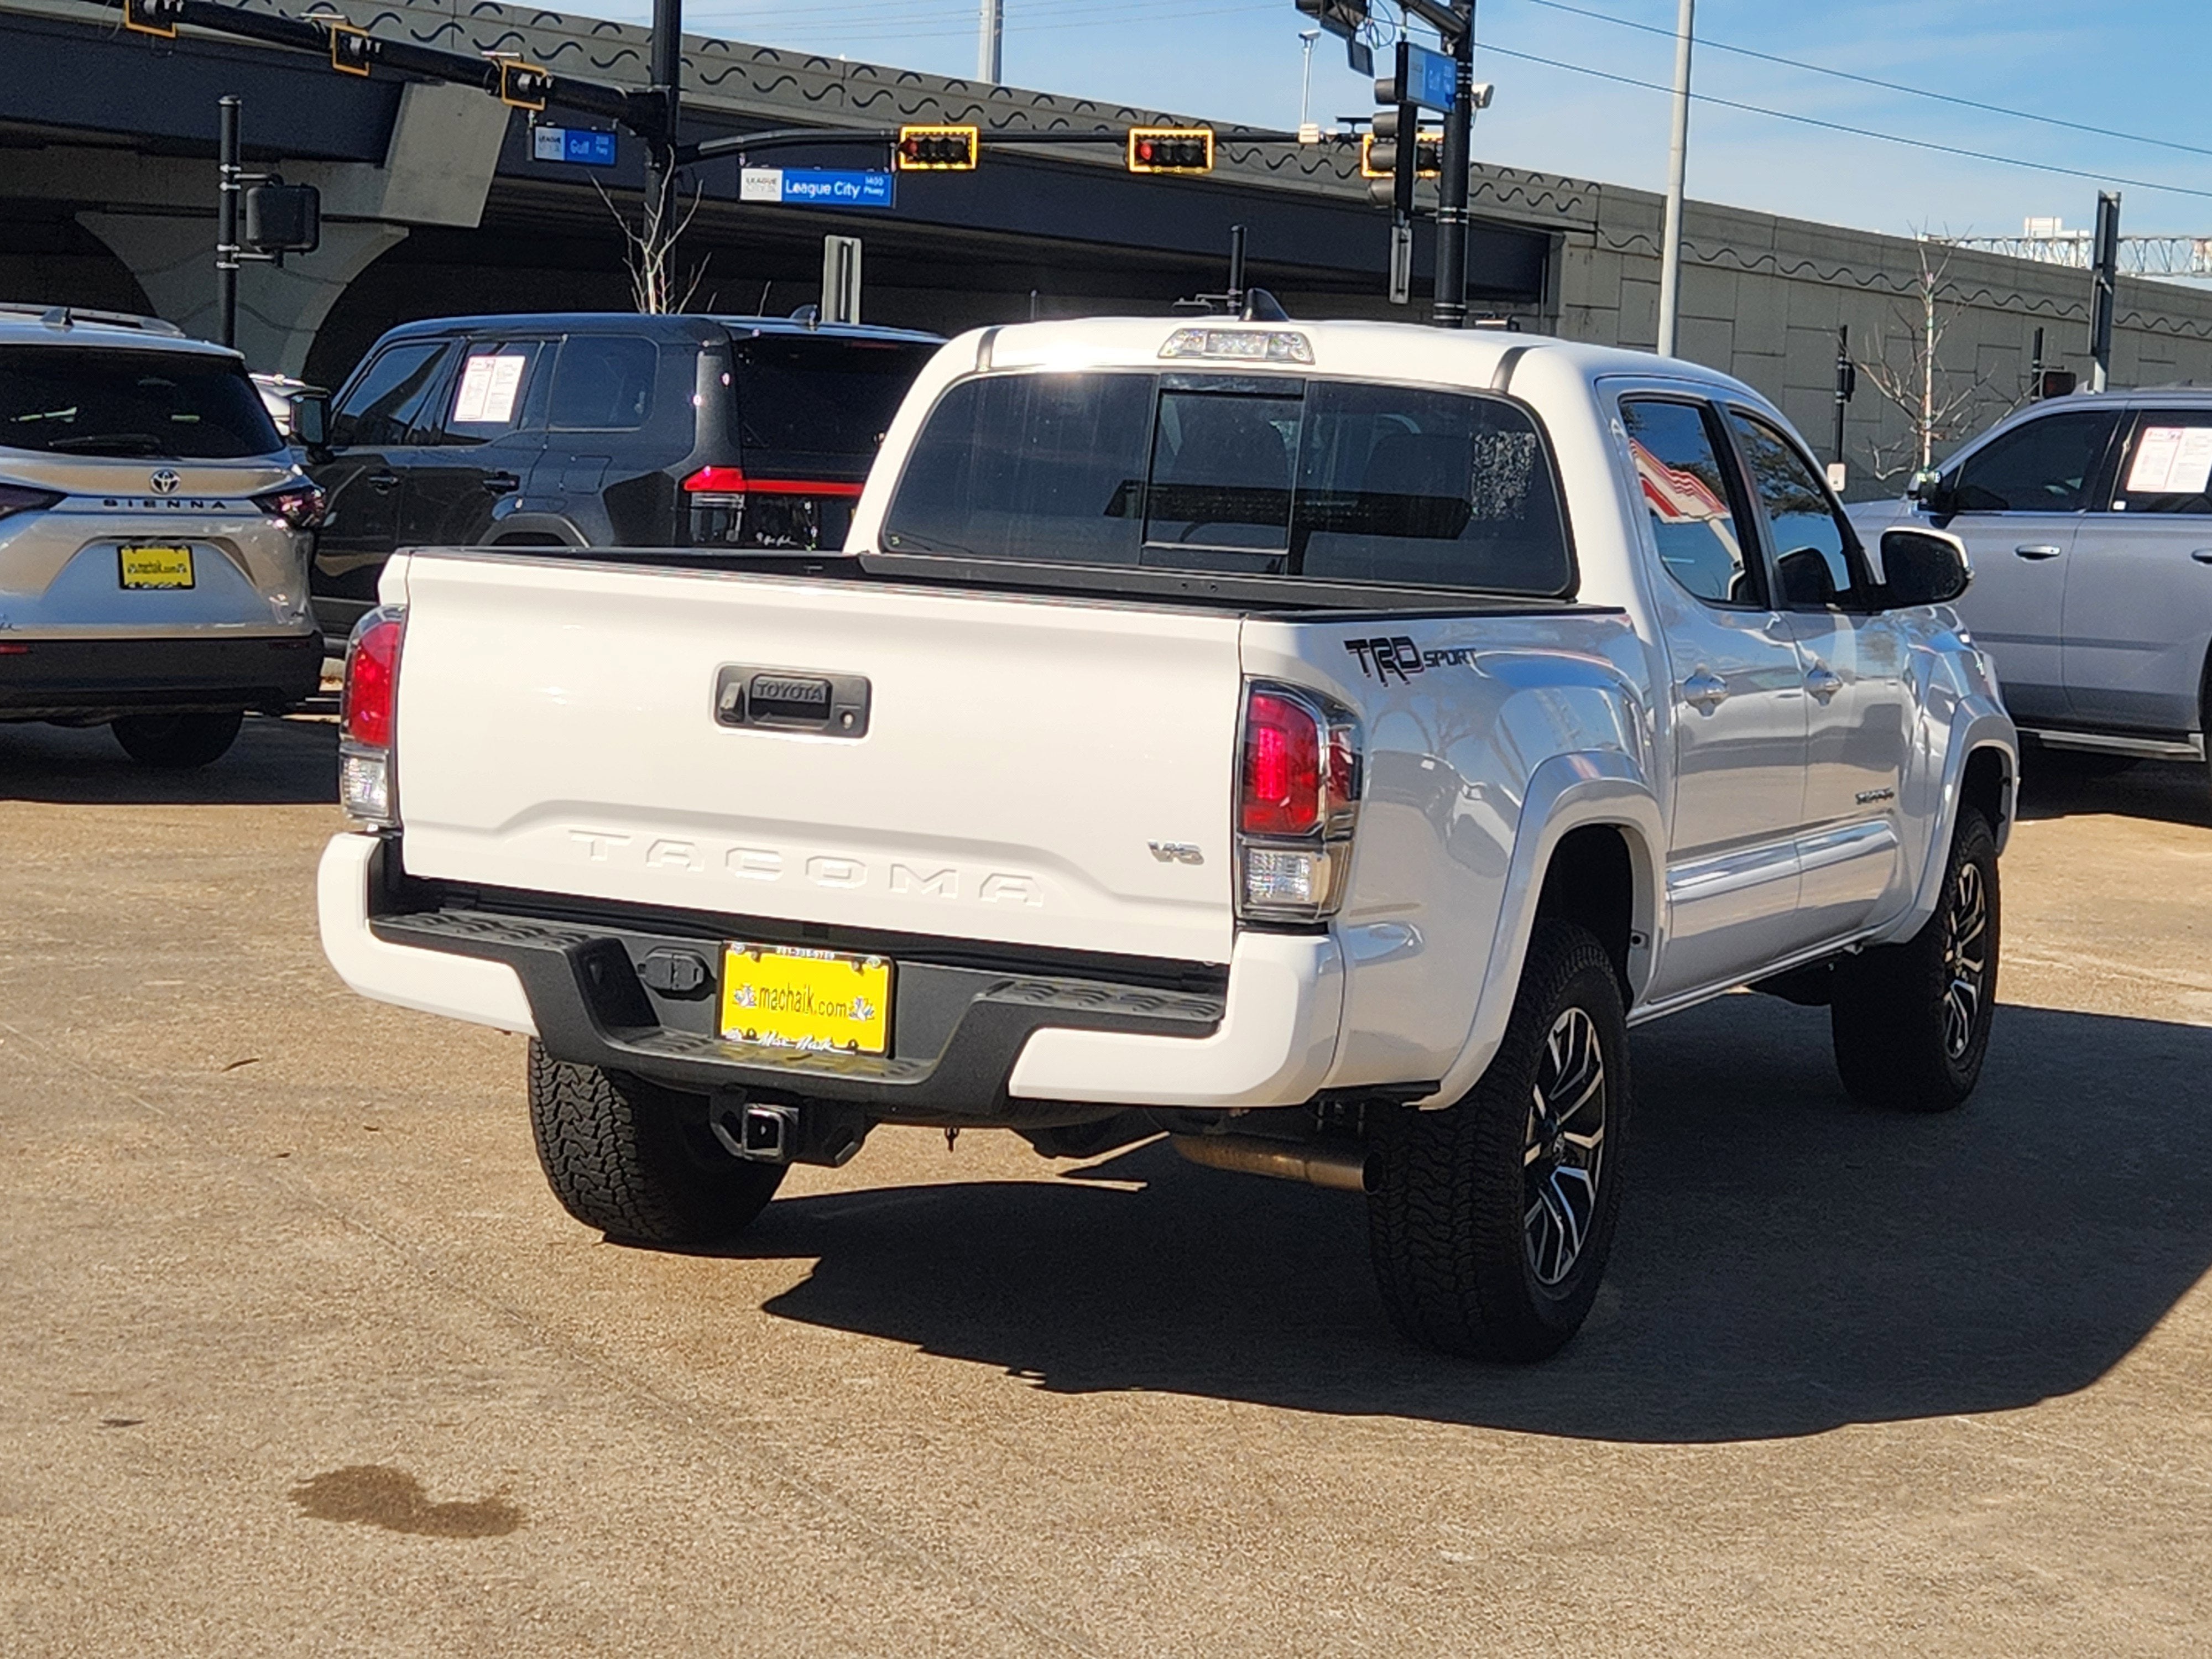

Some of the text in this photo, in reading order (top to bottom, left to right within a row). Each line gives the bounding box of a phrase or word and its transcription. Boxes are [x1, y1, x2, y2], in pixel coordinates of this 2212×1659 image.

[785, 179, 861, 199] League City
[103, 499, 226, 509] SIENNA
[1344, 637, 1476, 687] TRD SPORT
[756, 684, 823, 701] TOYOTA
[1147, 841, 1204, 865] V6
[568, 830, 1044, 907] TACOMA
[759, 982, 848, 1018] machaik.com
